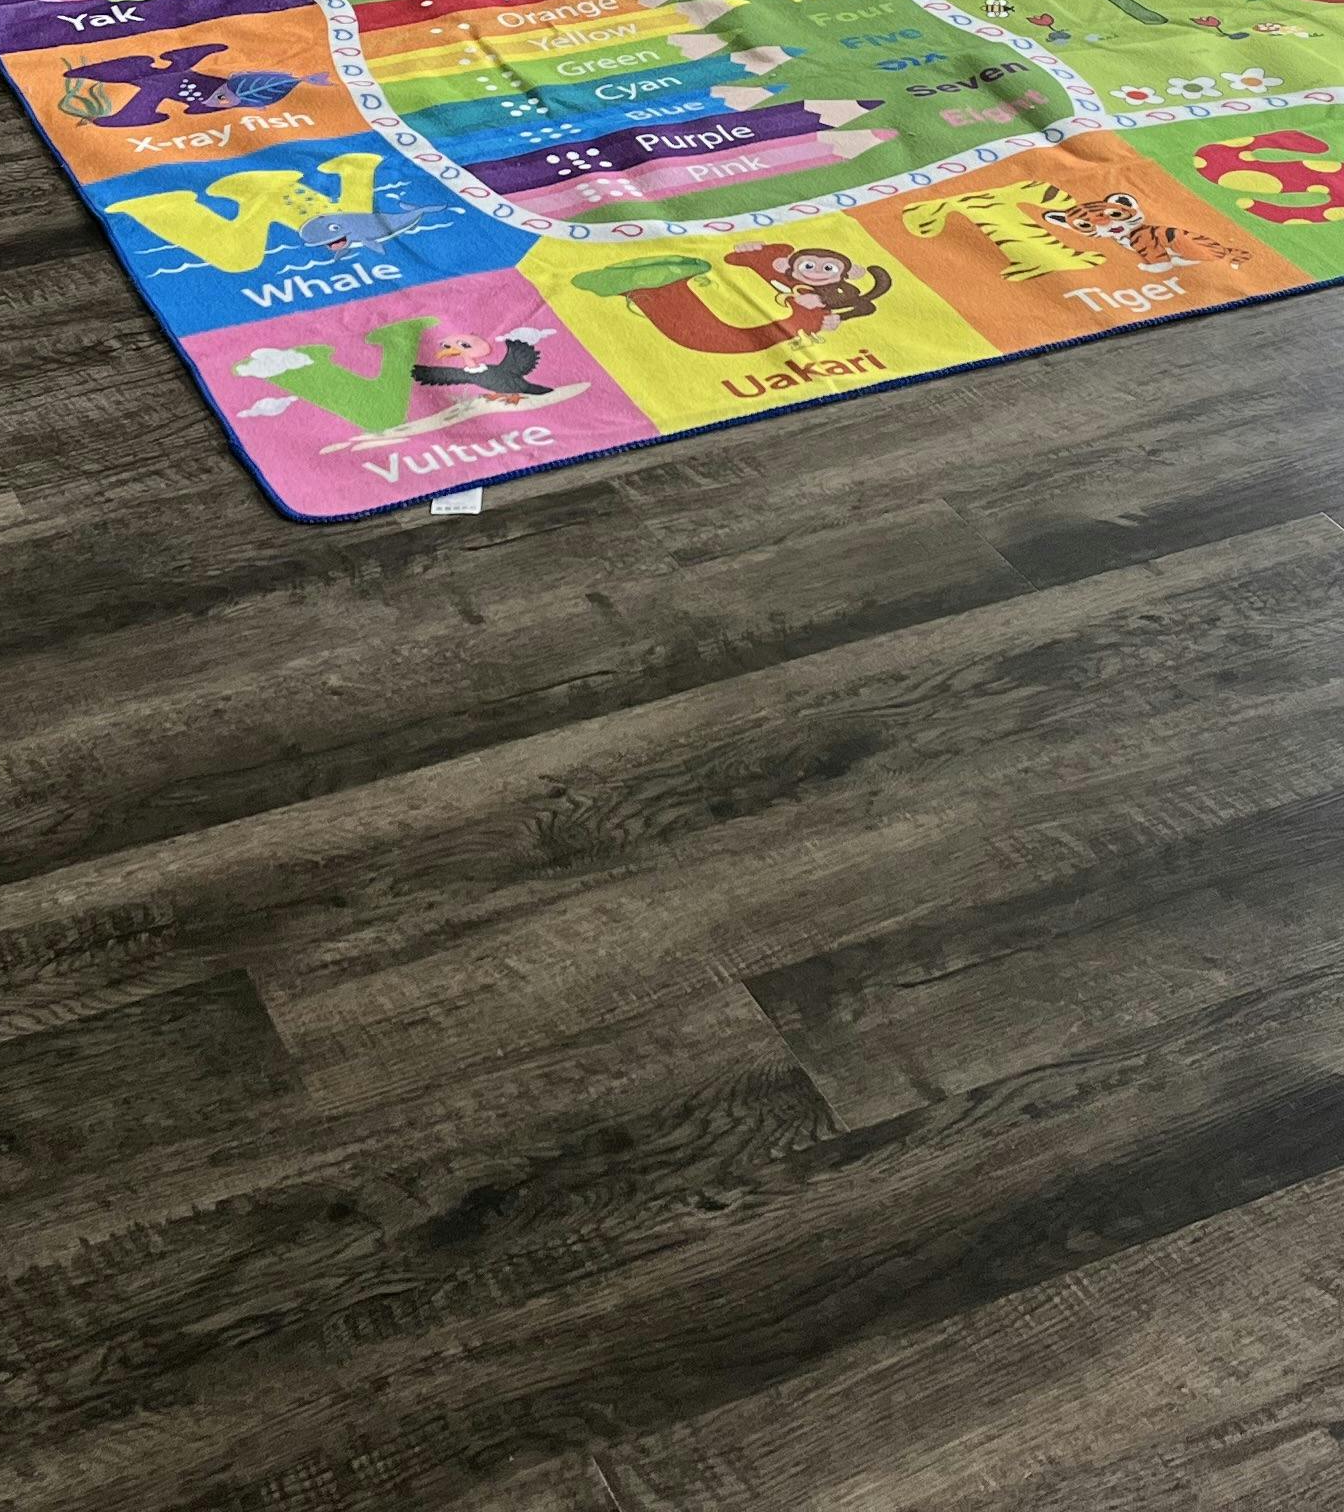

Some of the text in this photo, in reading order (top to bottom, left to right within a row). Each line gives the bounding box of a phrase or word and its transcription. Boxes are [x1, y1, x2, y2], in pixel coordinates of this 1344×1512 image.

[57, 3, 146, 33] Yak
[807, 2, 895, 28] Four
[526, 20, 639, 53] Yellow
[555, 47, 661, 78] Green
[594, 73, 683, 103] Cyan
[905, 61, 1030, 98] Seven
[624, 98, 706, 122] Blue
[127, 110, 316, 155] X-ray fish
[633, 122, 756, 155] Purple
[684, 154, 773, 187] Pink
[241, 256, 403, 310] Whale
[1062, 270, 1188, 316] Tiger
[719, 347, 889, 405] Uakari
[361, 419, 556, 485] Vulture
